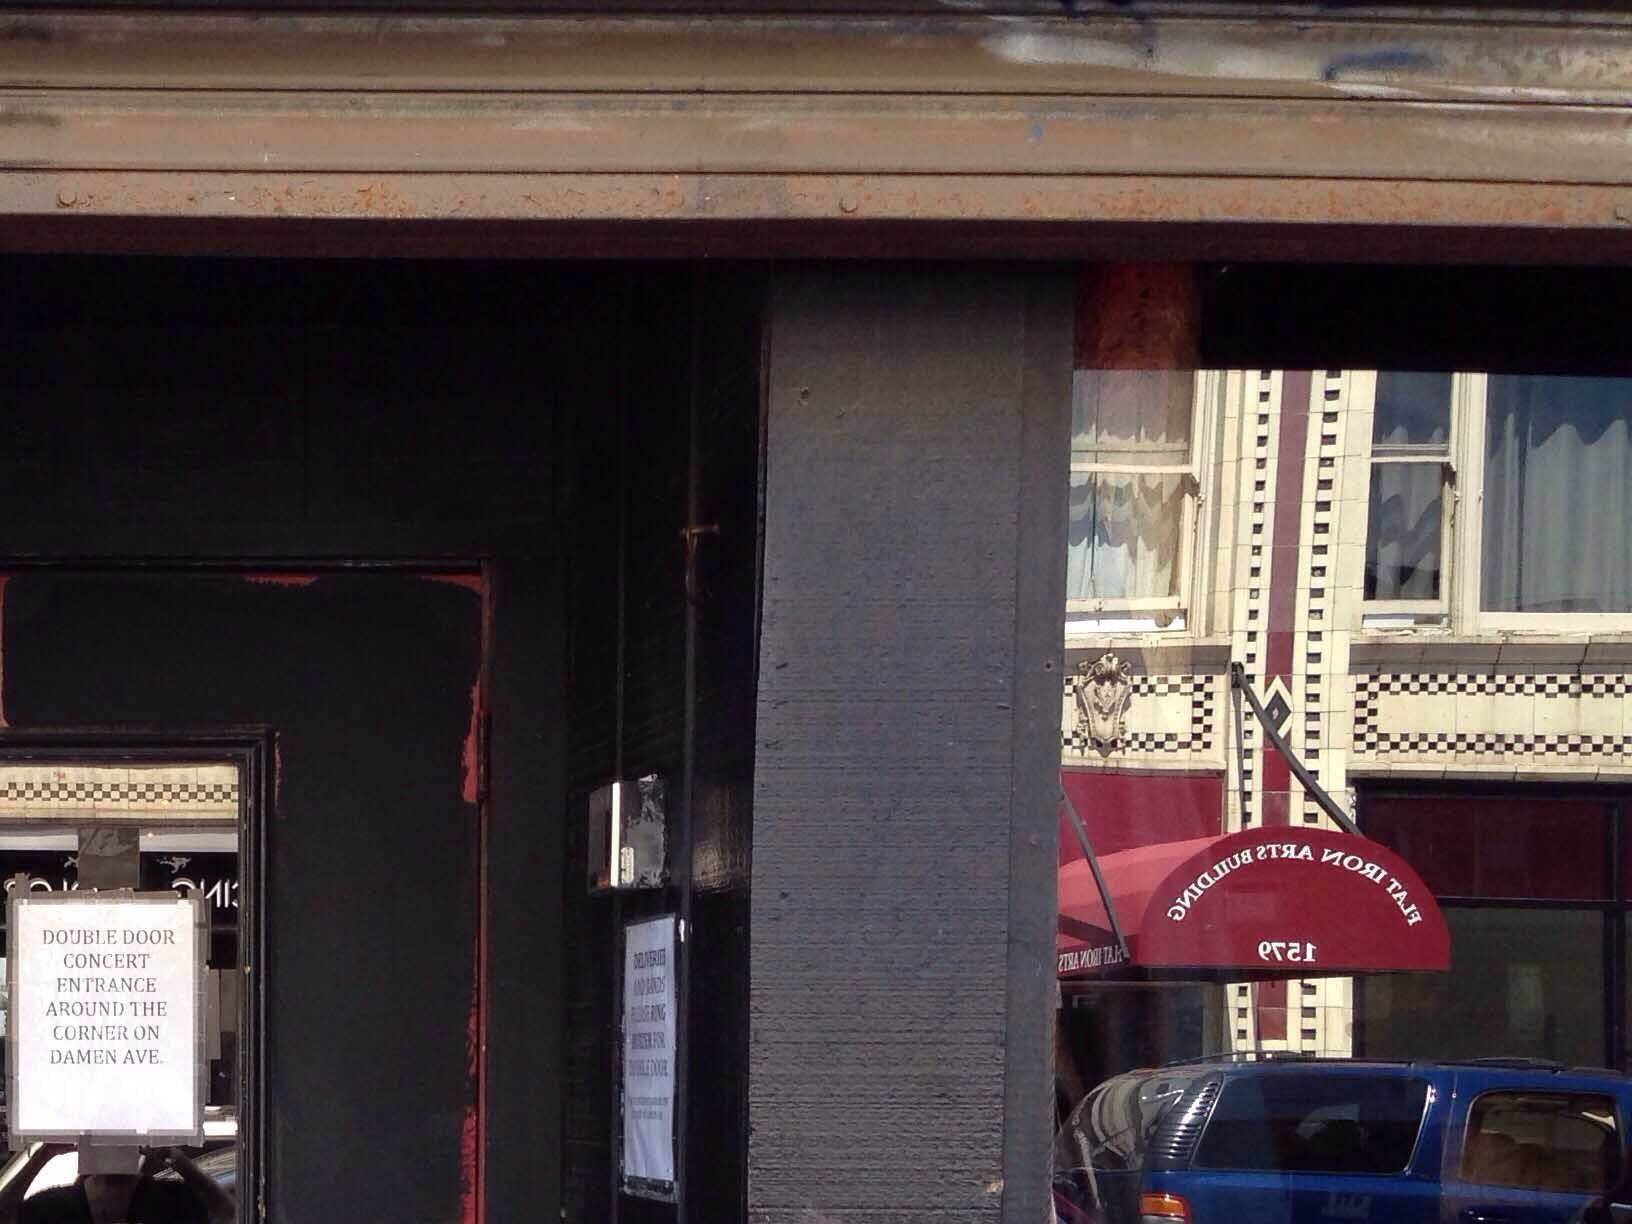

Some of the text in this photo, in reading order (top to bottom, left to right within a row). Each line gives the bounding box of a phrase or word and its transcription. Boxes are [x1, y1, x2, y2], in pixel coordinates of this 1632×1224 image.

[42, 929, 175, 945] DOUBLE DOOR
[63, 953, 150, 969] CONCERT
[57, 977, 157, 993] ENTRANCE
[45, 1001, 168, 1017] AROUND THE
[52, 1024, 160, 1041] CORNER ON
[50, 1048, 164, 1065] DAMEN AVE.
